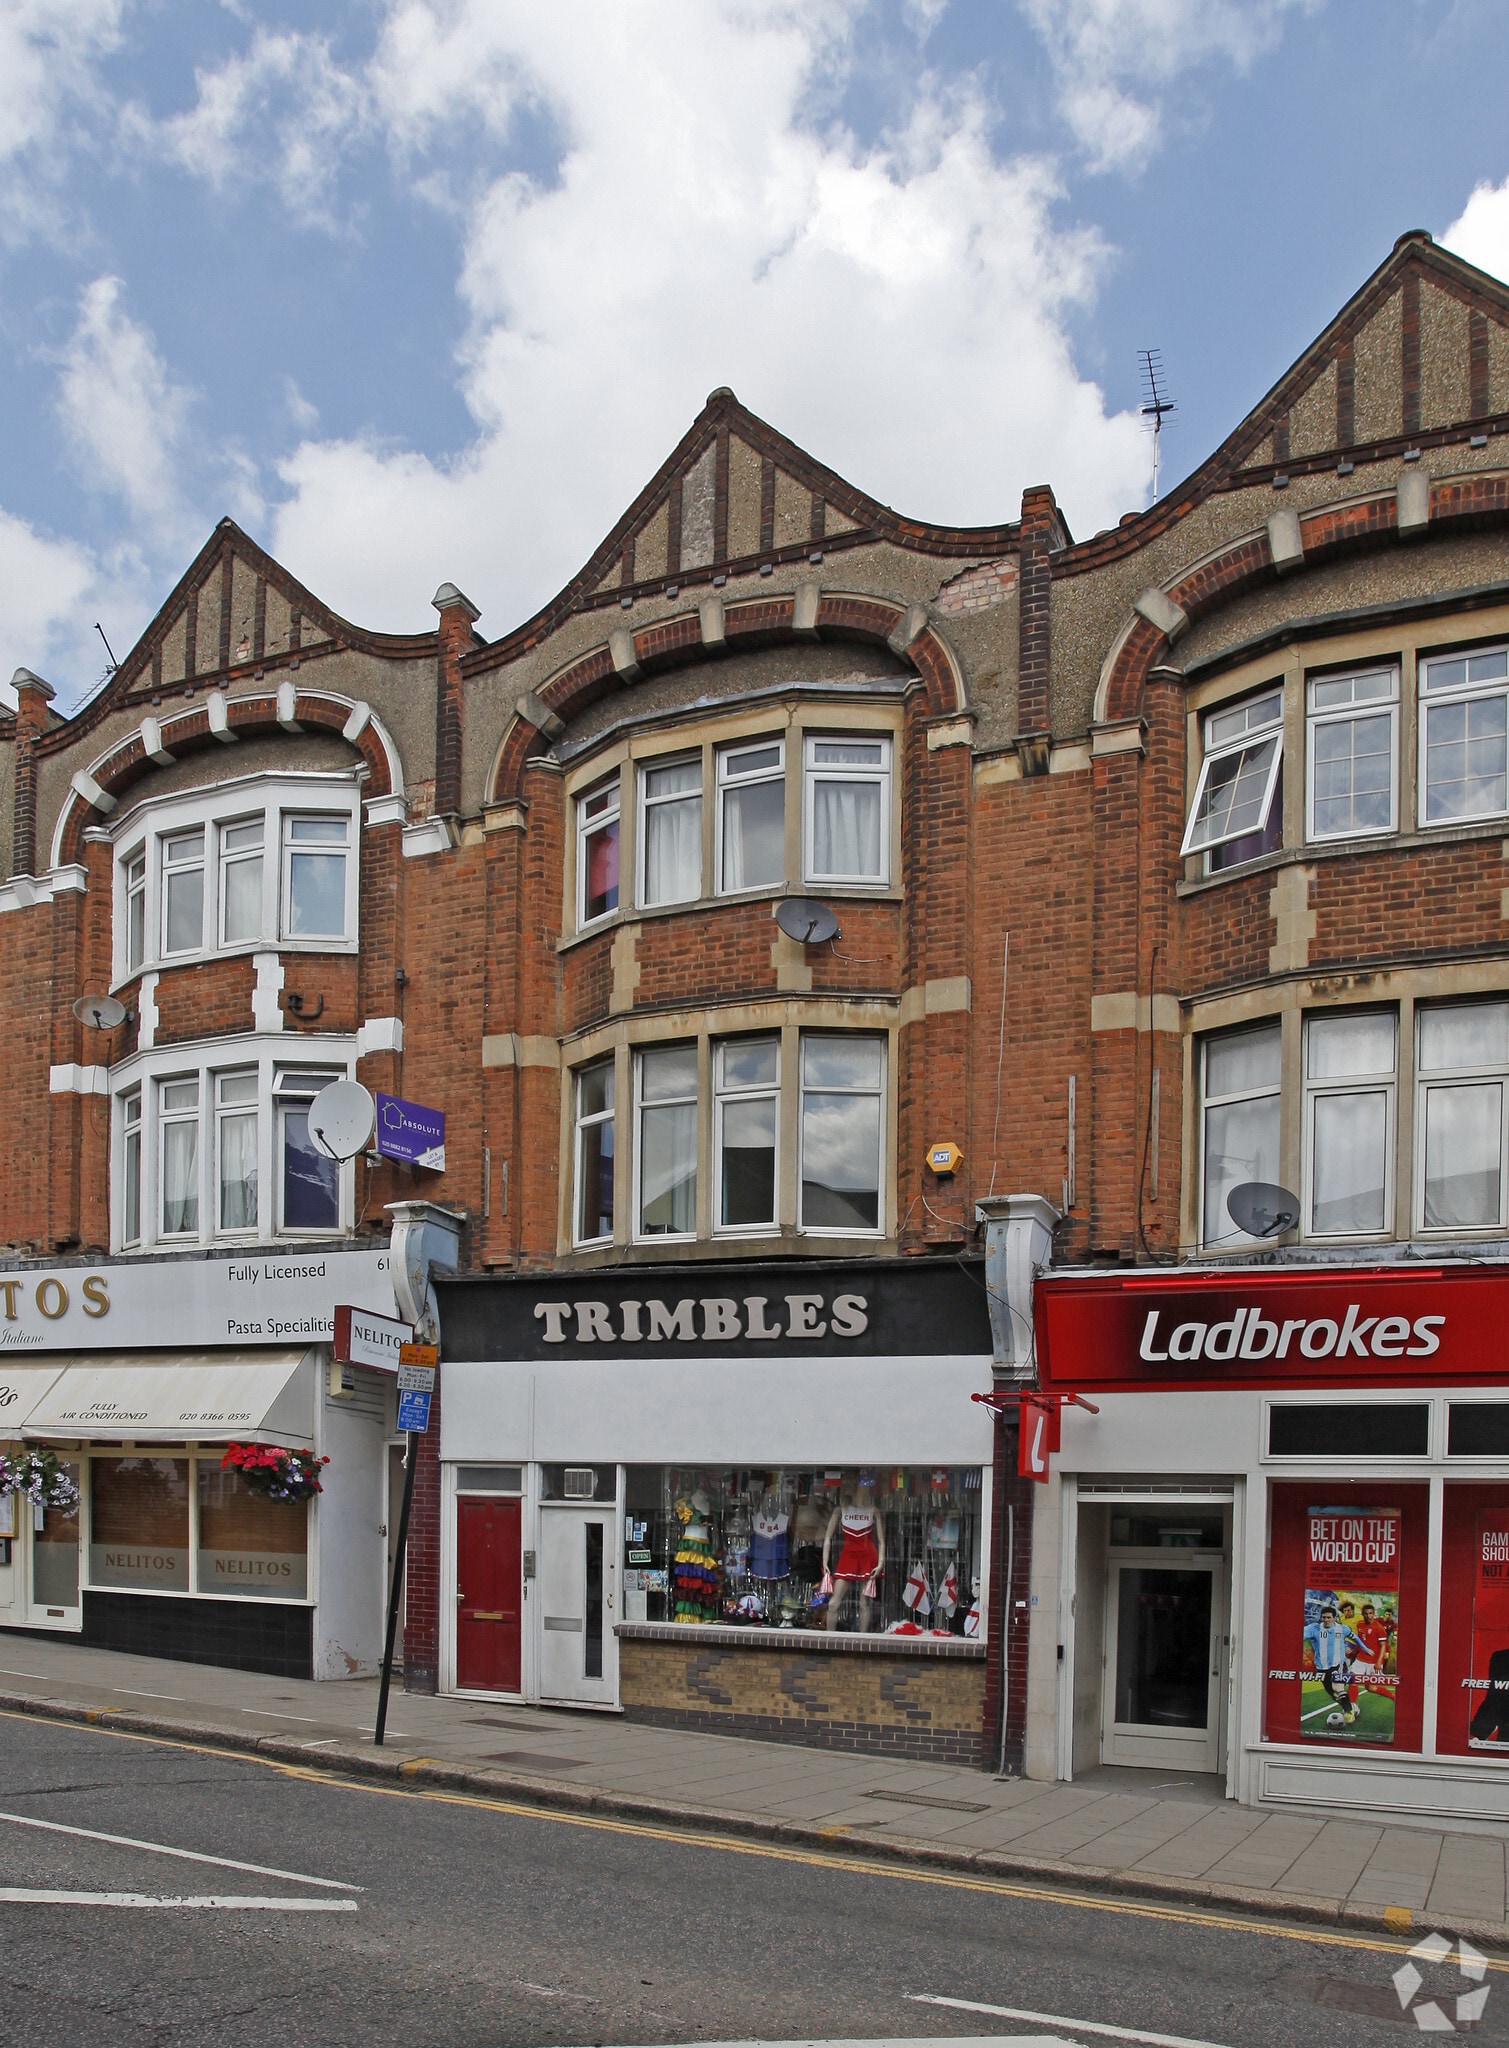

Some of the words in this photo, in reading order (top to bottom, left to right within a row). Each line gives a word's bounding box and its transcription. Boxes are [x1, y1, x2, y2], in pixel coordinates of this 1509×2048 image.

[403, 1120, 440, 1136] ABSOLUTE
[934, 1153, 949, 1161] ADT
[228, 1266, 259, 1284] Fully
[265, 1261, 326, 1279] Licensed
[534, 1294, 869, 1343] TRIMBLES
[228, 1320, 262, 1334] Pasta
[1140, 1305, 1446, 1361] Ladbrokes
[403, 1393, 412, 1403] P
[1310, 1519, 1339, 1540] BET
[1342, 1520, 1363, 1540] ON
[1367, 1520, 1396, 1541] THE
[1483, 1532, 1508, 1546] GAM
[1310, 1542, 1362, 1562] WORLD
[1366, 1542, 1395, 1563] CUP
[105, 1553, 175, 1570] NELITOS
[216, 1560, 291, 1576] NELITOS
[1482, 1564, 1504, 1576] NOT
[1269, 1670, 1296, 1680] FREE
[1299, 1671, 1325, 1681] WI-FI
[1334, 1674, 1352, 1684] sky
[1355, 1676, 1400, 1685] SPORTS
[1461, 1678, 1491, 1688] FREE
